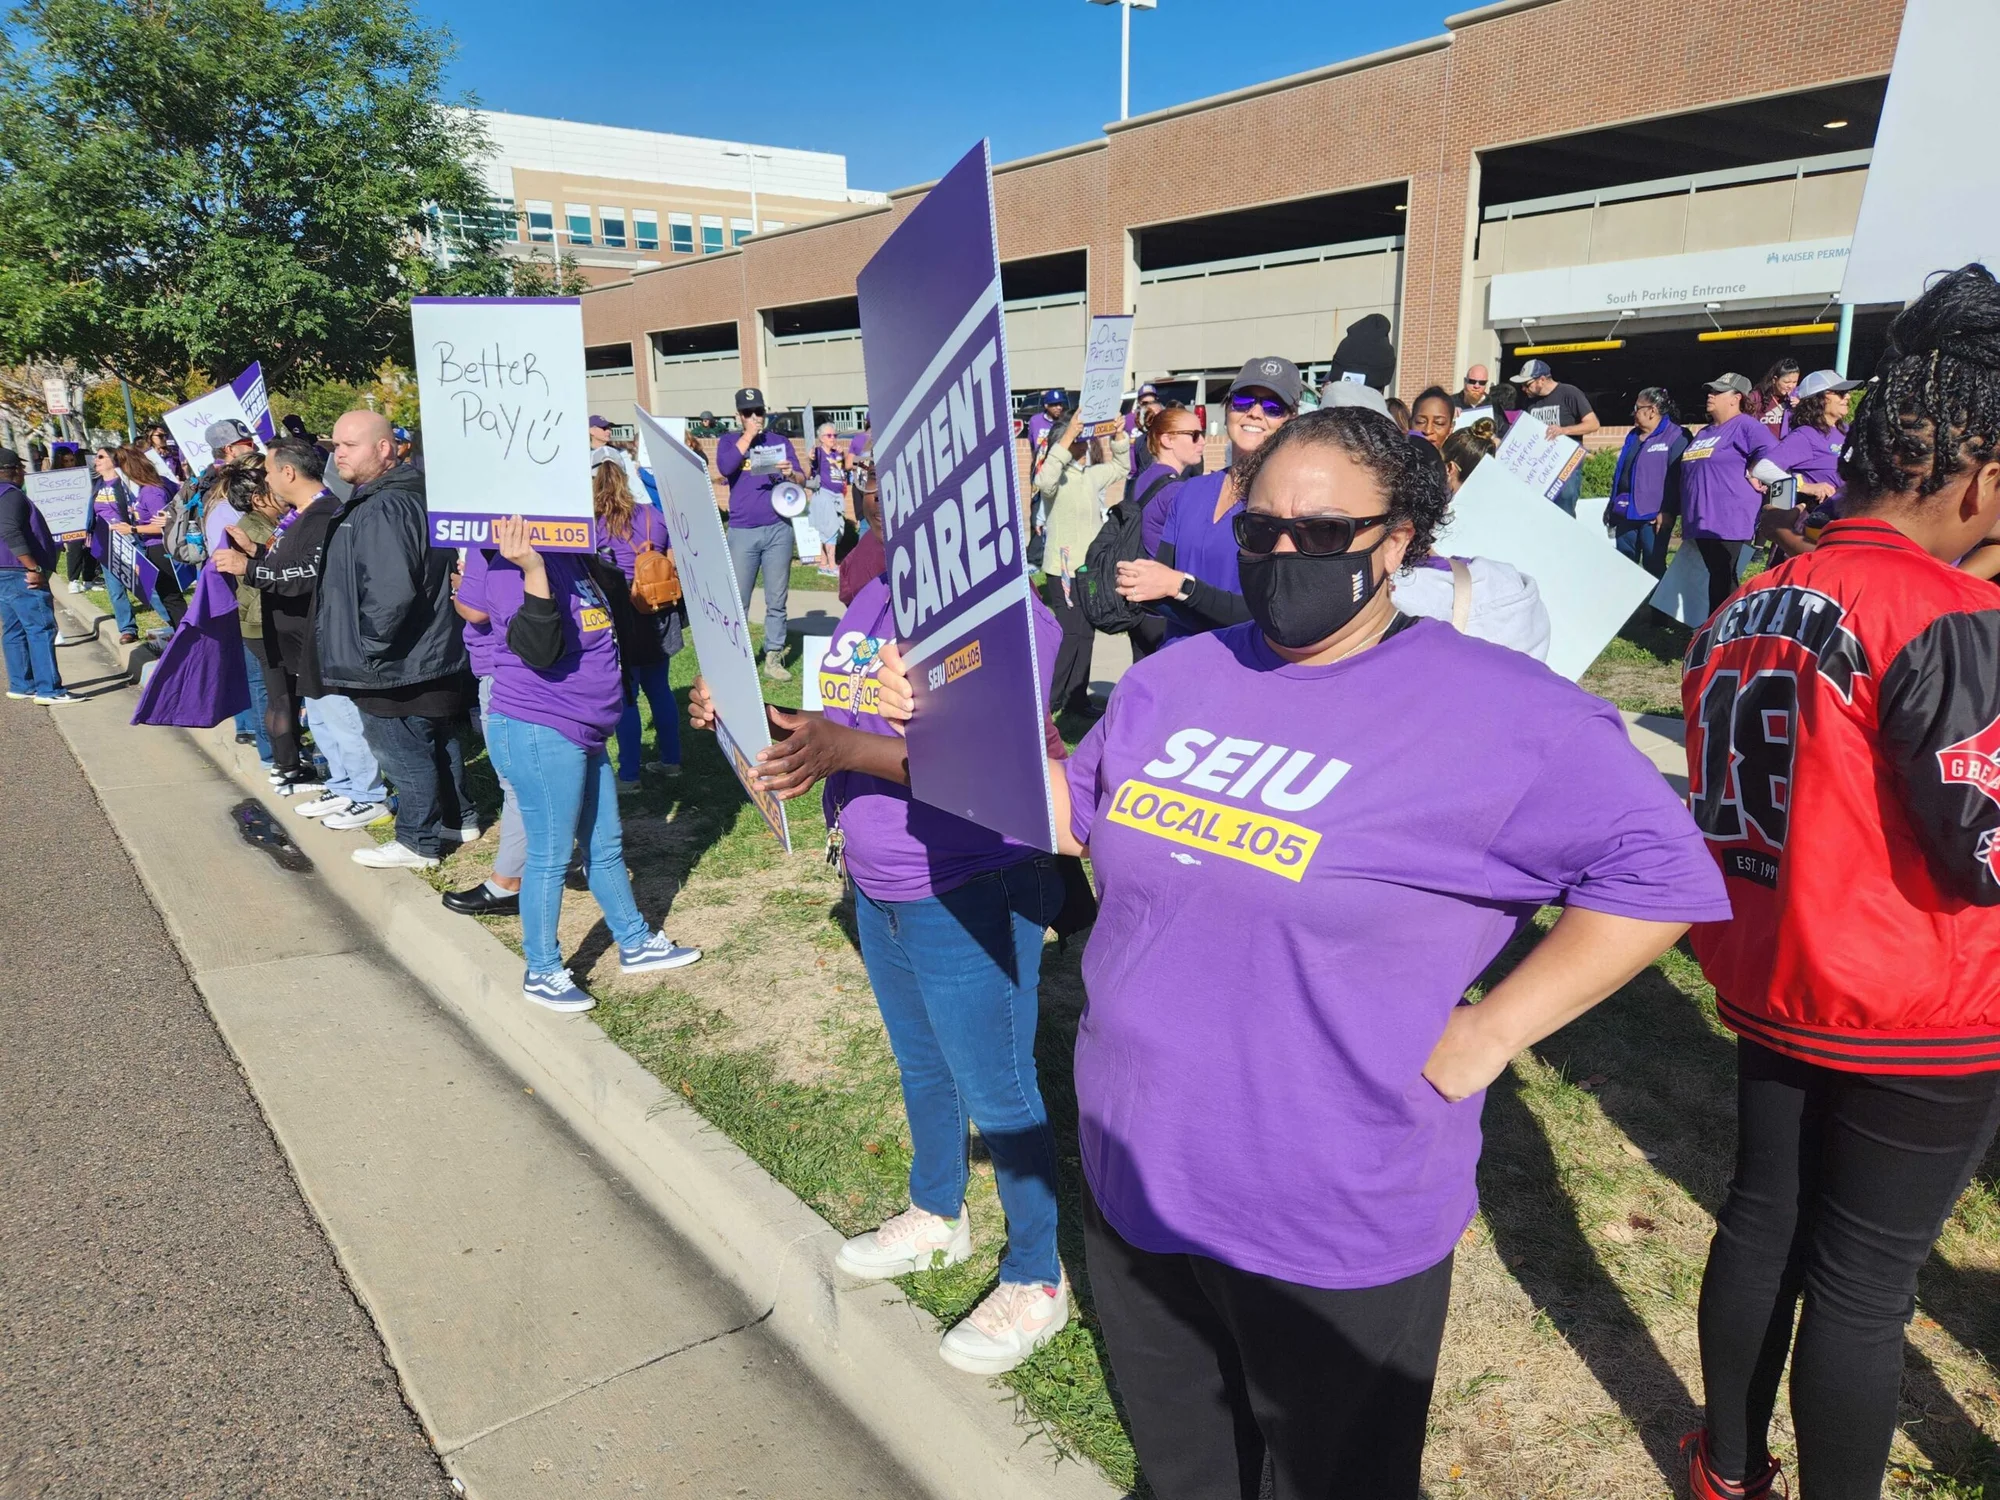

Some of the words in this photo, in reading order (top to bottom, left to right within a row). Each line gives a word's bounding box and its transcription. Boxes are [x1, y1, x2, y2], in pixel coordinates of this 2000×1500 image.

[1782, 251, 1814, 263] KAISER
[1817, 248, 1851, 260] PERMA
[1606, 292, 1637, 305] South
[1642, 286, 1687, 303] Parking
[1692, 283, 1746, 298] Entrance
[1735, 329, 1770, 337] CLEARANCE
[245, 392, 267, 421] ARE!
[745, 389, 755, 401] S
[184, 411, 213, 429] We
[451, 390, 521, 460] Pay
[1081, 427, 1094, 438] EIU
[1760, 415, 1783, 425] adi
[880, 336, 998, 541] PATIENT
[1500, 438, 1521, 464] SAFE
[1687, 436, 1722, 452] SEIU
[1509, 433, 1540, 474] STAFFING
[1546, 479, 1564, 500] SEIU
[1560, 459, 1576, 480] LOCAL
[34, 493, 85, 505] EALTHCARE
[45, 506, 83, 519] ORKERS
[62, 530, 85, 541] LOCAL
[435, 519, 489, 542] SEIU
[494, 520, 551, 543] LAL
[555, 528, 587, 543] 105
[891, 445, 1014, 639] CARE!
[111, 530, 122, 579] PATIENT
[121, 538, 134, 588] CARE!
[1352, 570, 1363, 602] PINK
[1718, 589, 1828, 643] GOAT
[928, 662, 946, 691] SEIU
[946, 654, 967, 679] LOCAL
[967, 646, 980, 668] 105
[821, 678, 850, 701] LOC
[861, 685, 880, 707] 05
[1142, 728, 1352, 812] SEIU
[1690, 669, 1799, 852] 18
[1951, 758, 2000, 790] GREA
[1114, 786, 1221, 842] LOCAL
[1227, 821, 1308, 866] 105
[1736, 855, 1757, 874] EST.
